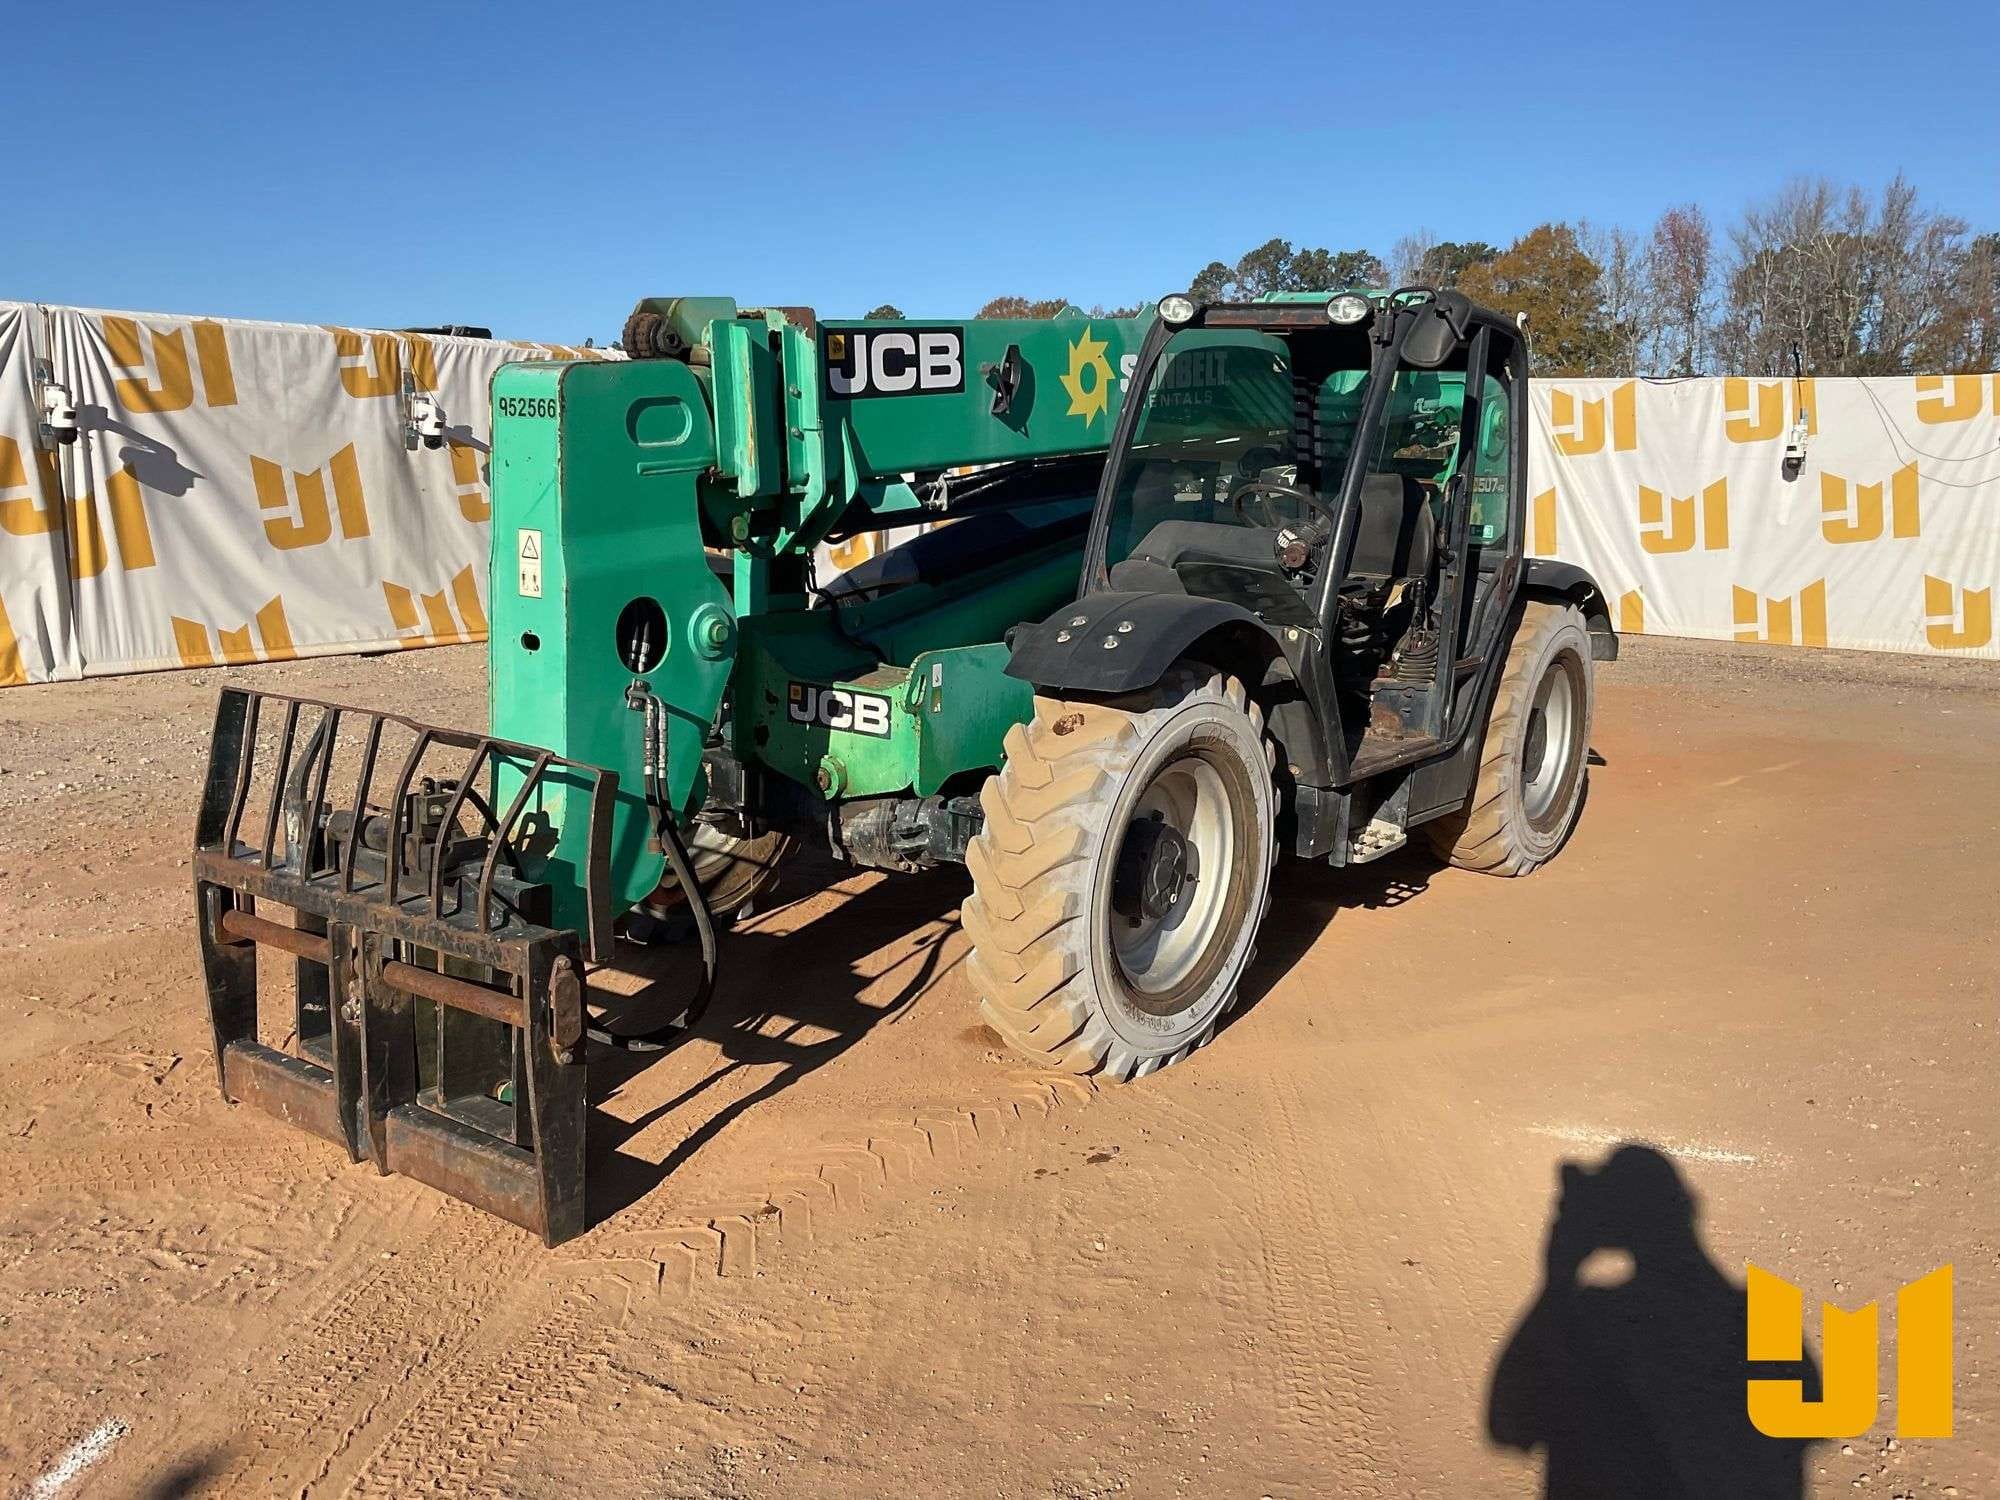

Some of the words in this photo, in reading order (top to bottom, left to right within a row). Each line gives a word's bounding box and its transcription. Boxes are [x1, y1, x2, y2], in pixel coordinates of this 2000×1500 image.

[829, 333, 963, 395] JCB
[499, 397, 556, 418] 952566
[1122, 391, 1214, 412] ENTALS
[789, 684, 890, 736] JCB
